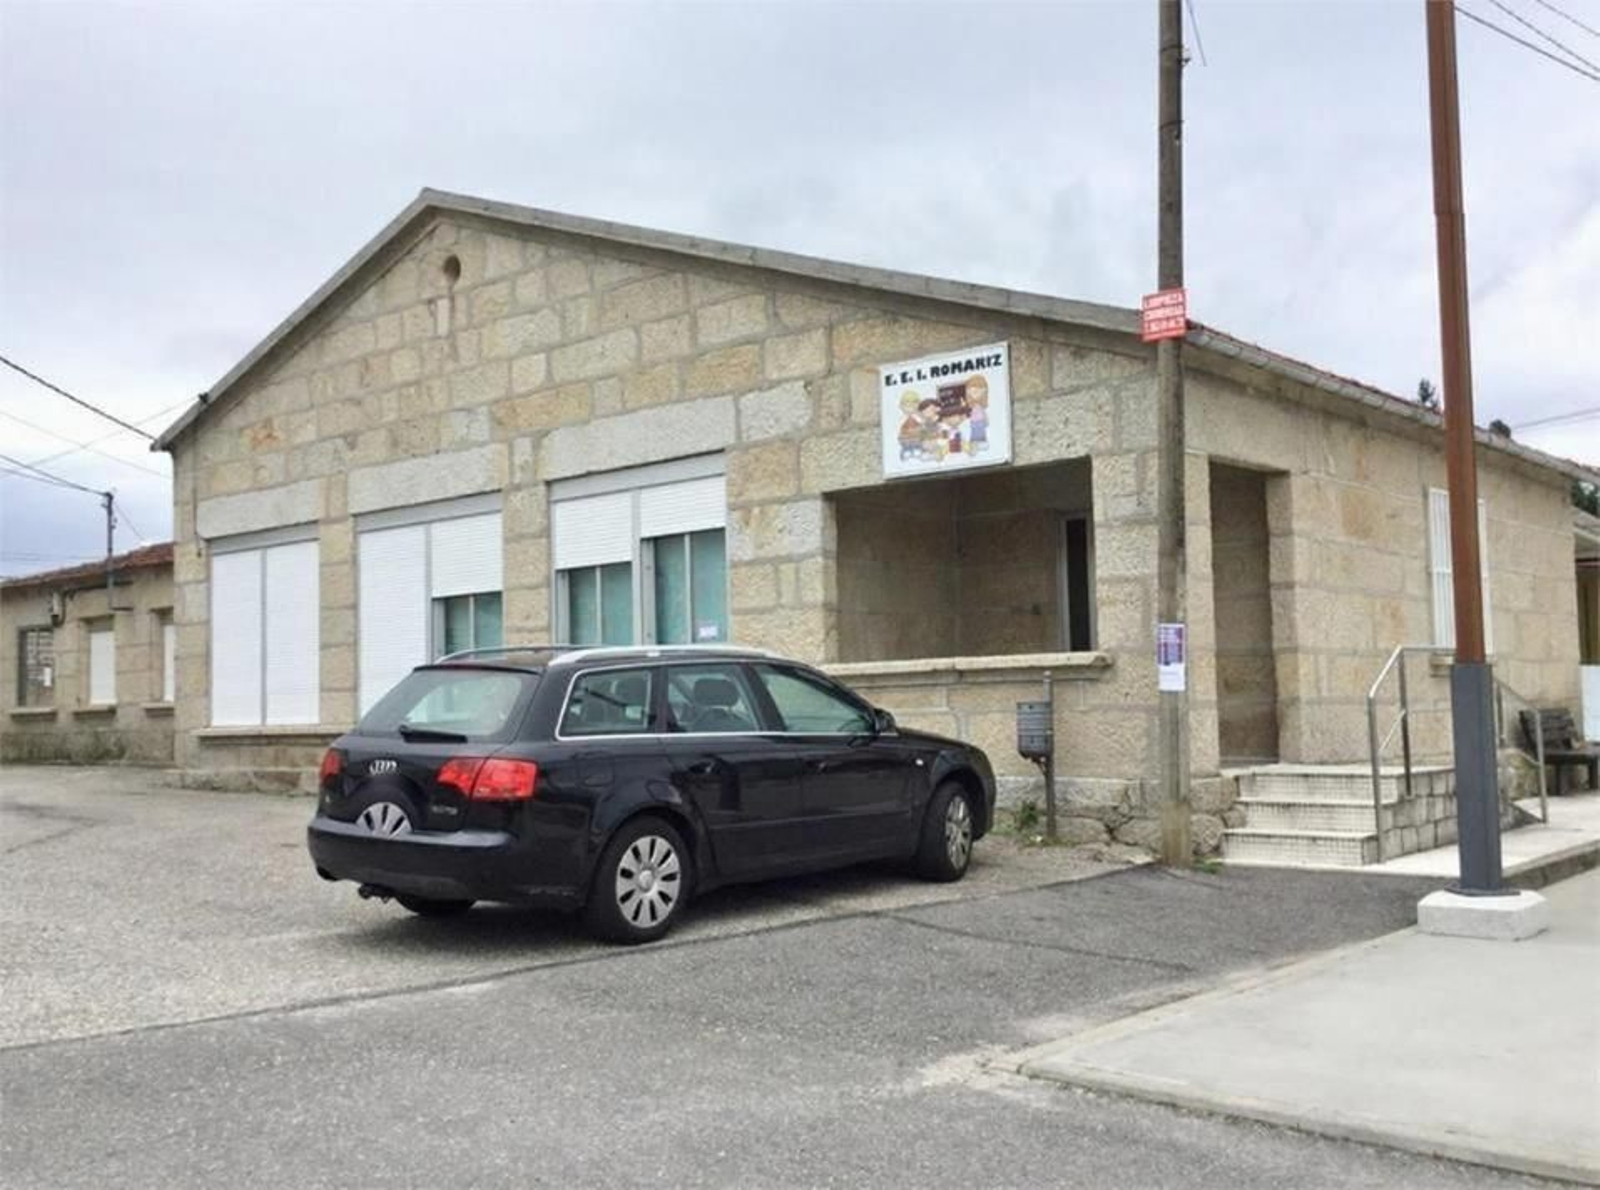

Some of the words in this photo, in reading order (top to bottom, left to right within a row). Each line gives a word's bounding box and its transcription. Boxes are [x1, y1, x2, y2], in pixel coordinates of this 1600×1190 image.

[885, 374, 897, 386] E.
[901, 371, 914, 384] E.
[917, 369, 927, 380] I.
[930, 353, 1003, 378] ROMARIZ
